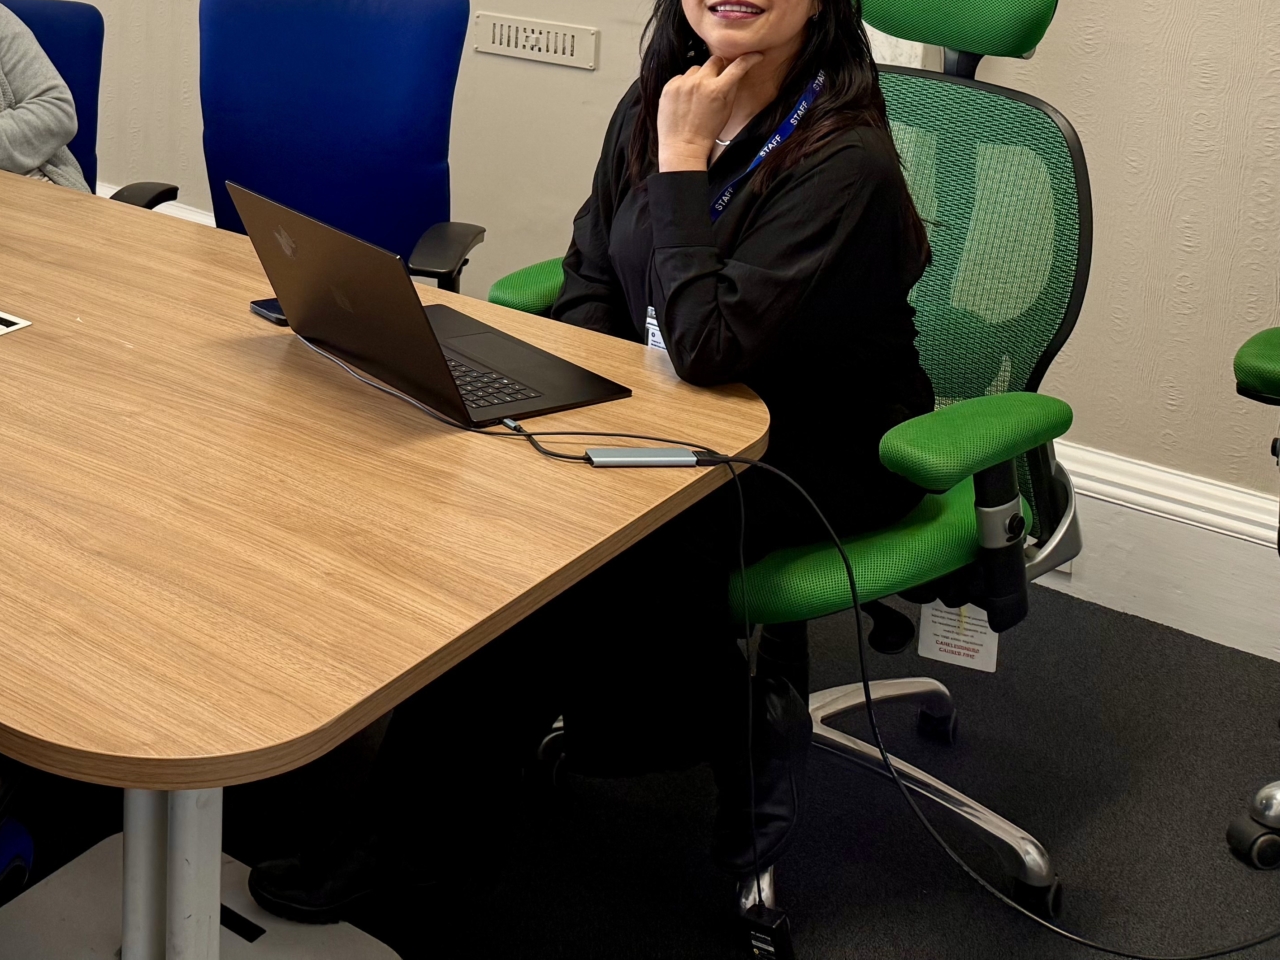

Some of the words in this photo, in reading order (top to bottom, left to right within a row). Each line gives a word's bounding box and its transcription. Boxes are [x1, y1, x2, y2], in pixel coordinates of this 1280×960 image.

[790, 100, 808, 126] STAFF
[759, 134, 782, 157] STAFF
[714, 187, 734, 211] STAFF
